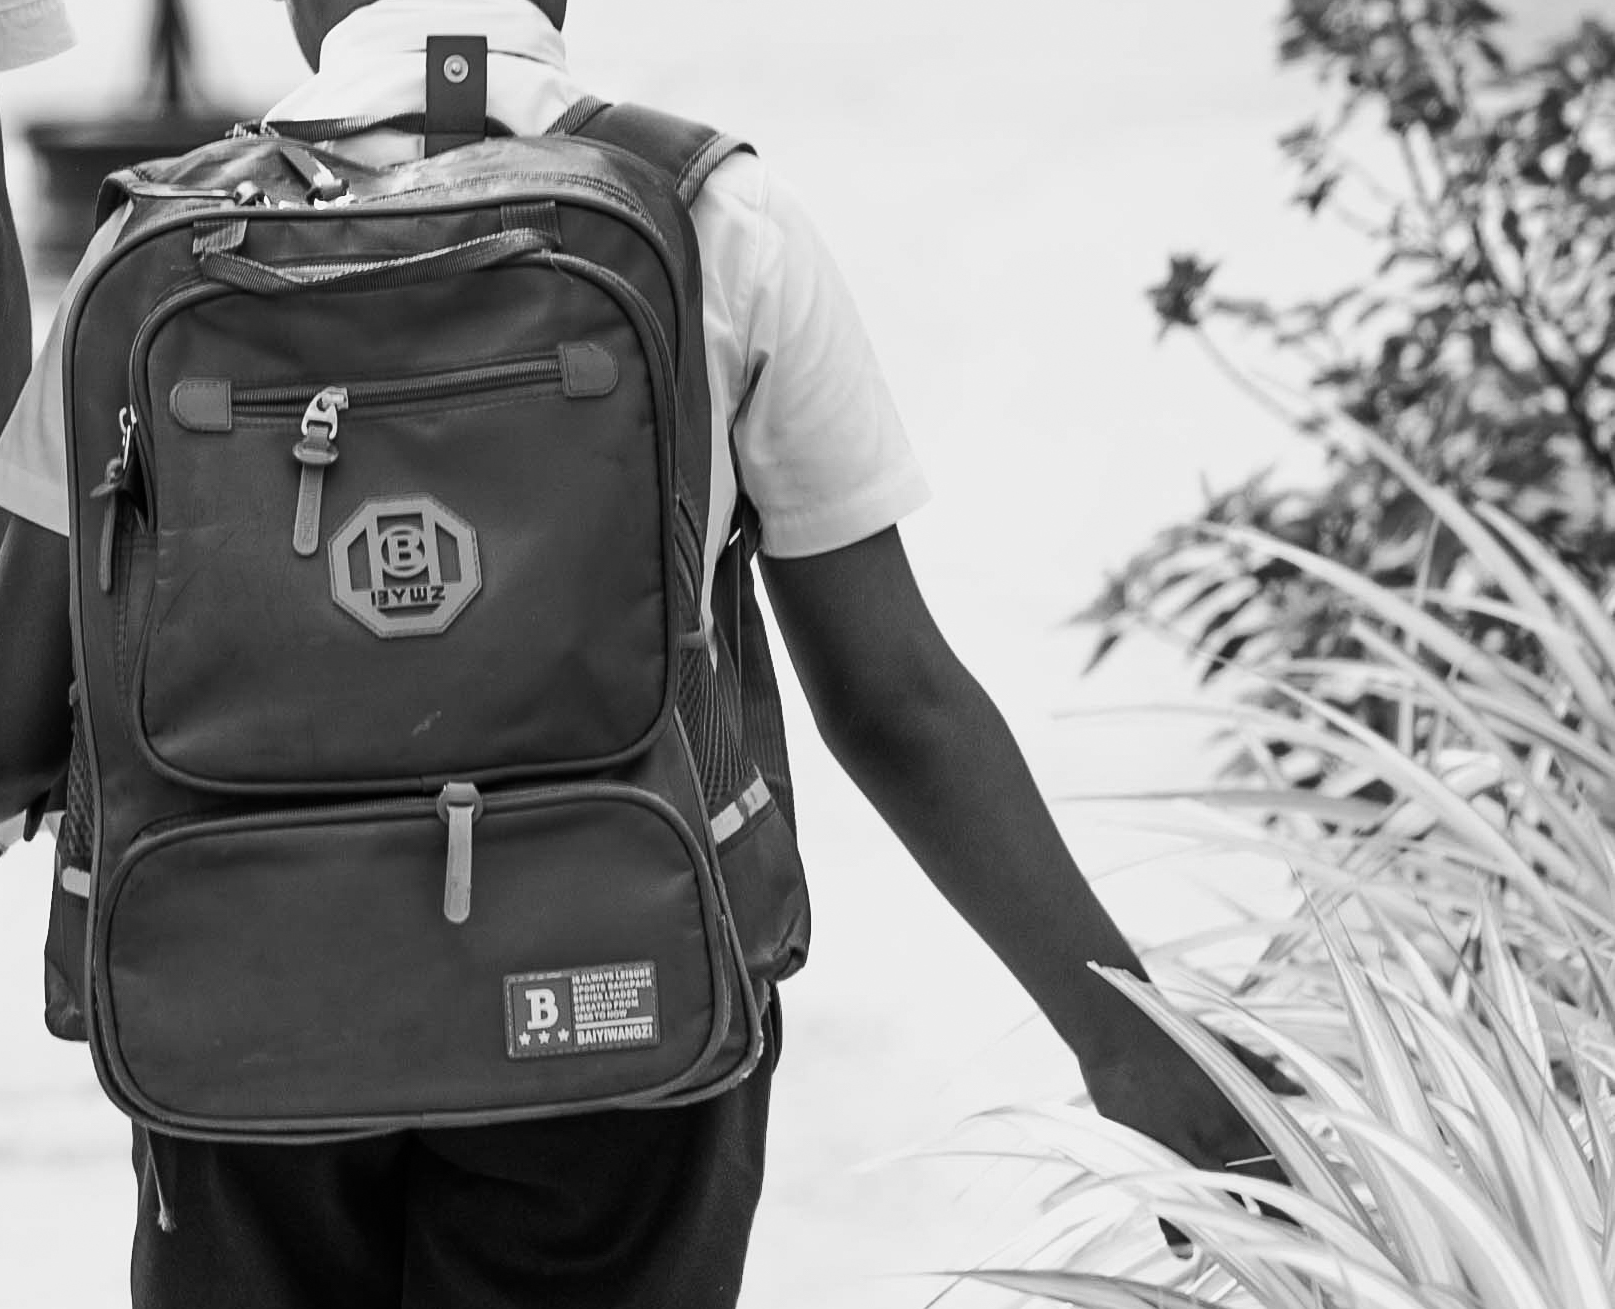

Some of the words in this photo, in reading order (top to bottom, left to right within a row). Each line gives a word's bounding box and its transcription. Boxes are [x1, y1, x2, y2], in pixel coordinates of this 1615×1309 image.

[525, 988, 559, 1030] B
[614, 998, 639, 1009] FROM
[607, 1009, 627, 1020] NOW
